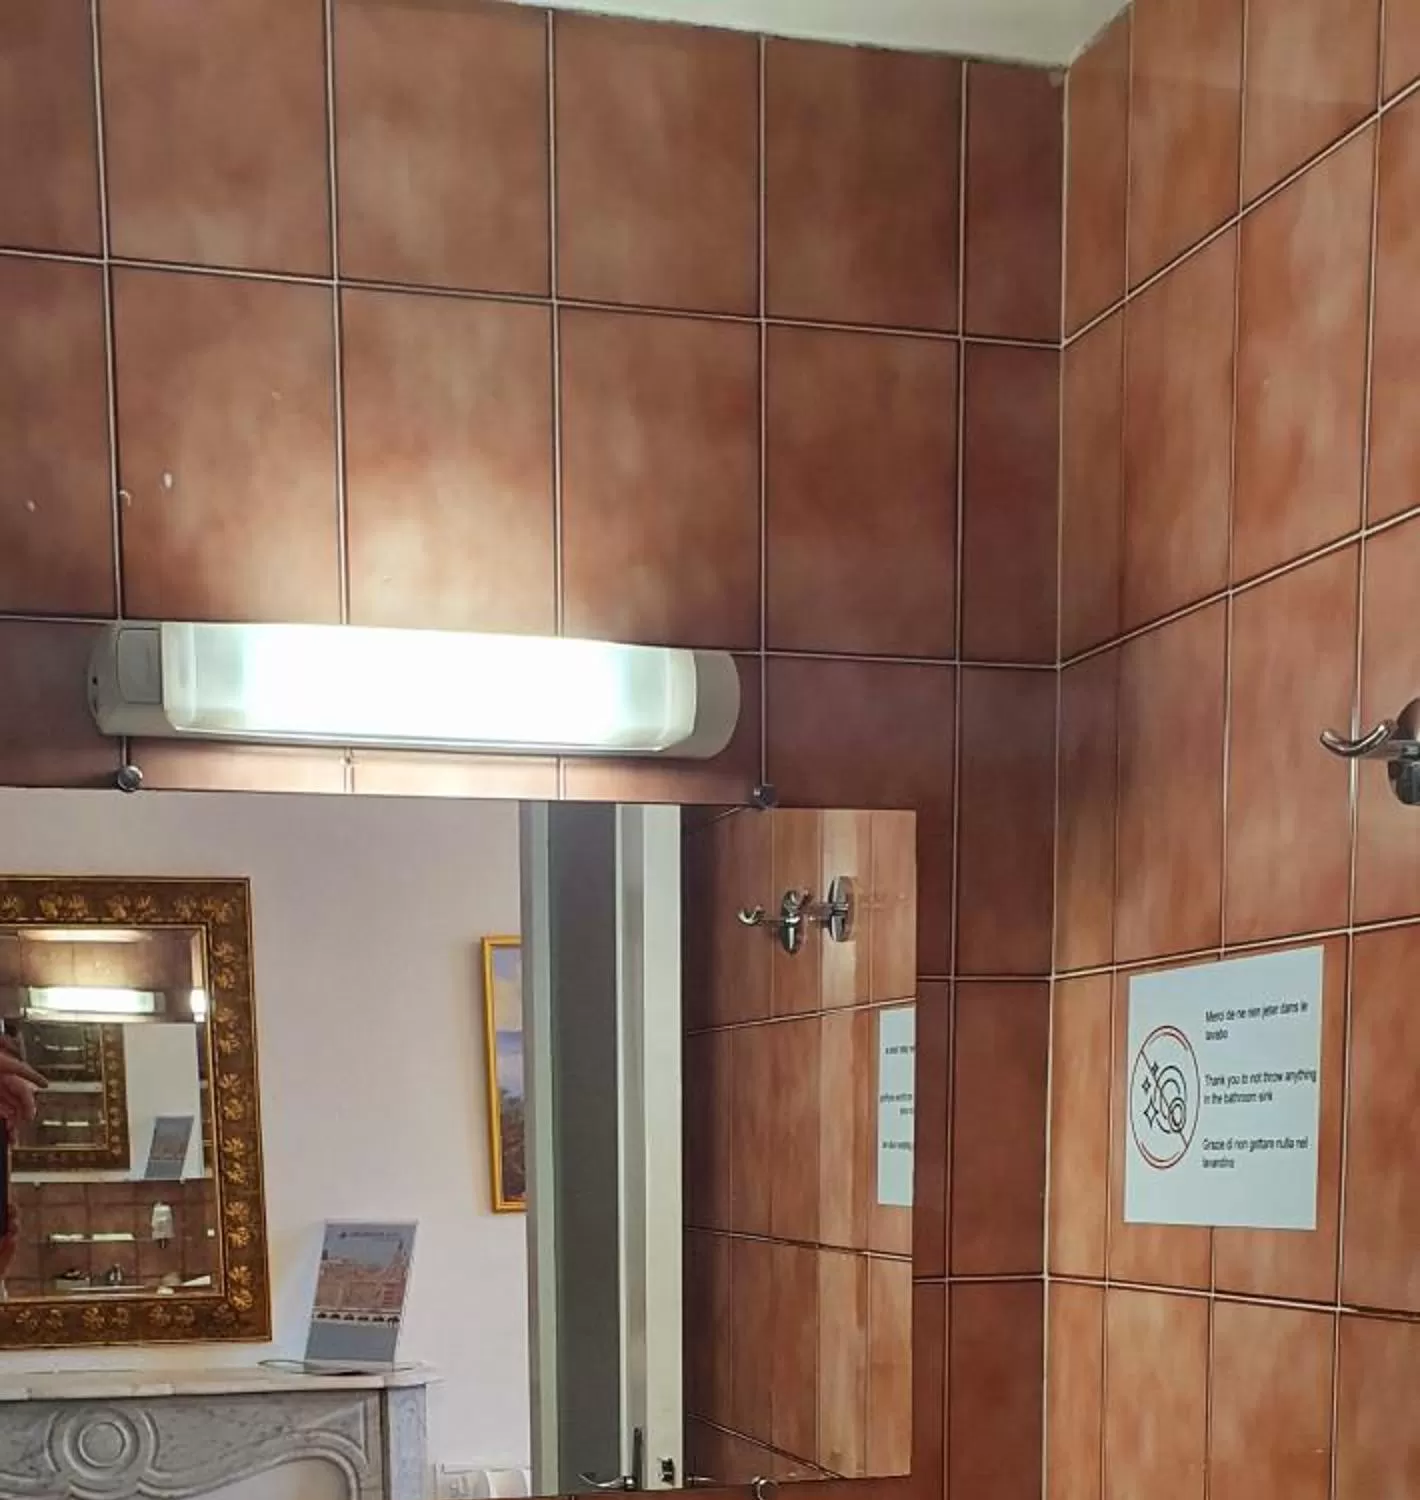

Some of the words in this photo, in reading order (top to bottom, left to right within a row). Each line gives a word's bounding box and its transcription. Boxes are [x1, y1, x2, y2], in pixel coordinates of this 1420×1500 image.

[1205, 1010, 1224, 1022] Merci
[1226, 1009, 1234, 1020] de
[1236, 1008, 1246, 1018] ne
[1280, 1002, 1298, 1014] dans
[1301, 1001, 1308, 1012] le
[1205, 1029, 1228, 1040] lavabo
[1204, 1073, 1224, 1086] Thank
[1227, 1075, 1240, 1088] you
[1242, 1073, 1248, 1084] to
[1250, 1072, 1262, 1084] not
[1264, 1071, 1282, 1082] throw
[1285, 1069, 1316, 1084] anything
[1204, 1094, 1210, 1104] in
[1212, 1092, 1222, 1104] the
[1224, 1092, 1256, 1103] bathroom
[1259, 1091, 1272, 1102] sink
[1235, 1139, 1247, 1149] non
